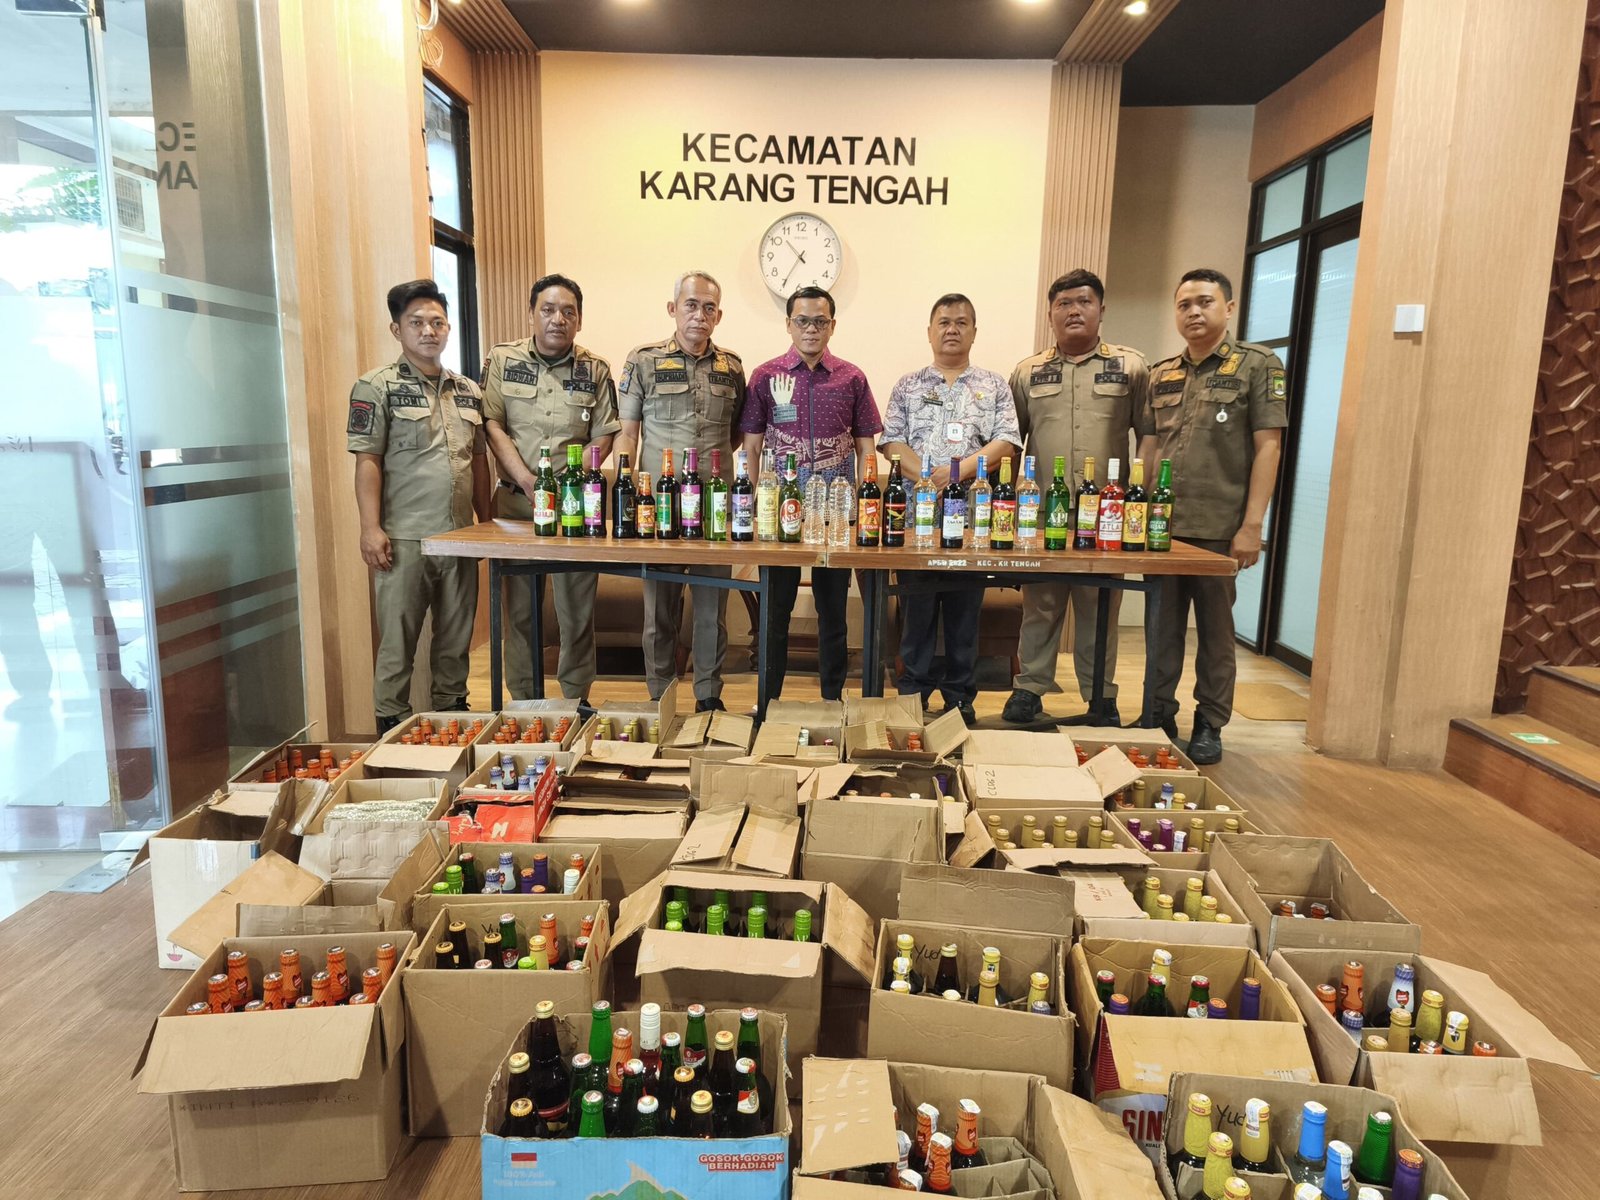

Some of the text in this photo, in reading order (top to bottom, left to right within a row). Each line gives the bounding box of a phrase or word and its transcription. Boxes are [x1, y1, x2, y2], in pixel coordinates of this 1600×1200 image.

[682, 133, 916, 166] KECAMATAN
[640, 171, 948, 205] KARANG TENGAH
[782, 226, 790, 236] 11
[795, 221, 807, 232] 12
[770, 236, 783, 247] 10
[824, 237, 831, 248] 2
[767, 252, 774, 262] 9
[826, 253, 834, 264] 3
[771, 267, 778, 277] 8
[822, 270, 829, 279] 4
[700, 1153, 784, 1162] GOSOK-GOSOK
[709, 1162, 775, 1170] BERHADIAH
